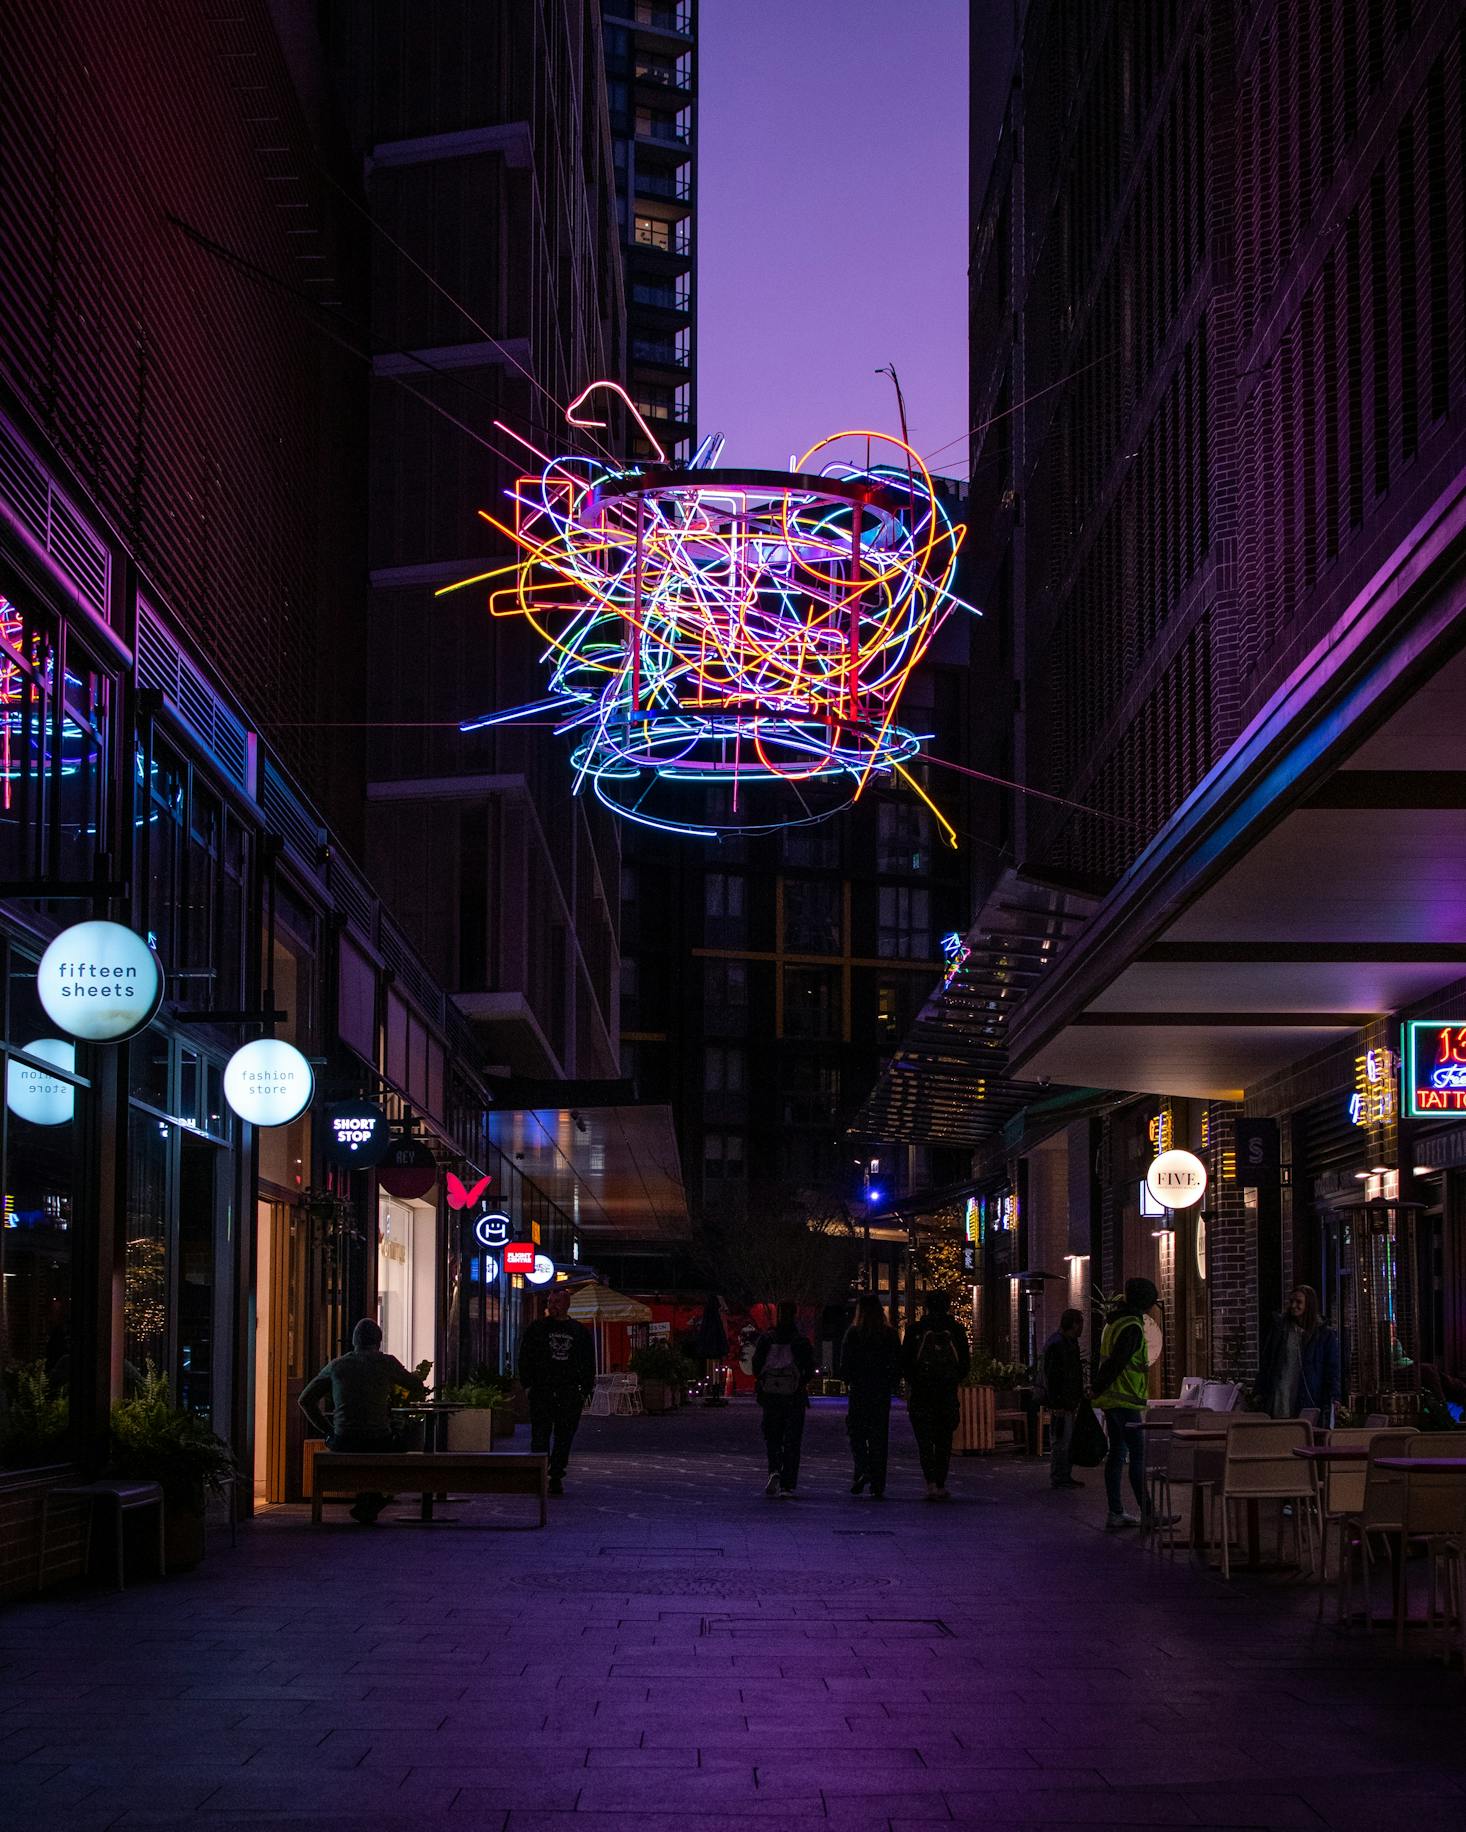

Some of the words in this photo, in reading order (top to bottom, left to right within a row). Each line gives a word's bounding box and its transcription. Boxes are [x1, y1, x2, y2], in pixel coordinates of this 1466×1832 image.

[59, 963, 137, 977] fifteen
[61, 982, 135, 997] sheets
[242, 1070, 294, 1081] fashion
[249, 1083, 287, 1095] store
[1417, 1090, 1466, 1109] TATT
[333, 1118, 376, 1130] SHORT
[337, 1130, 372, 1142] STOP
